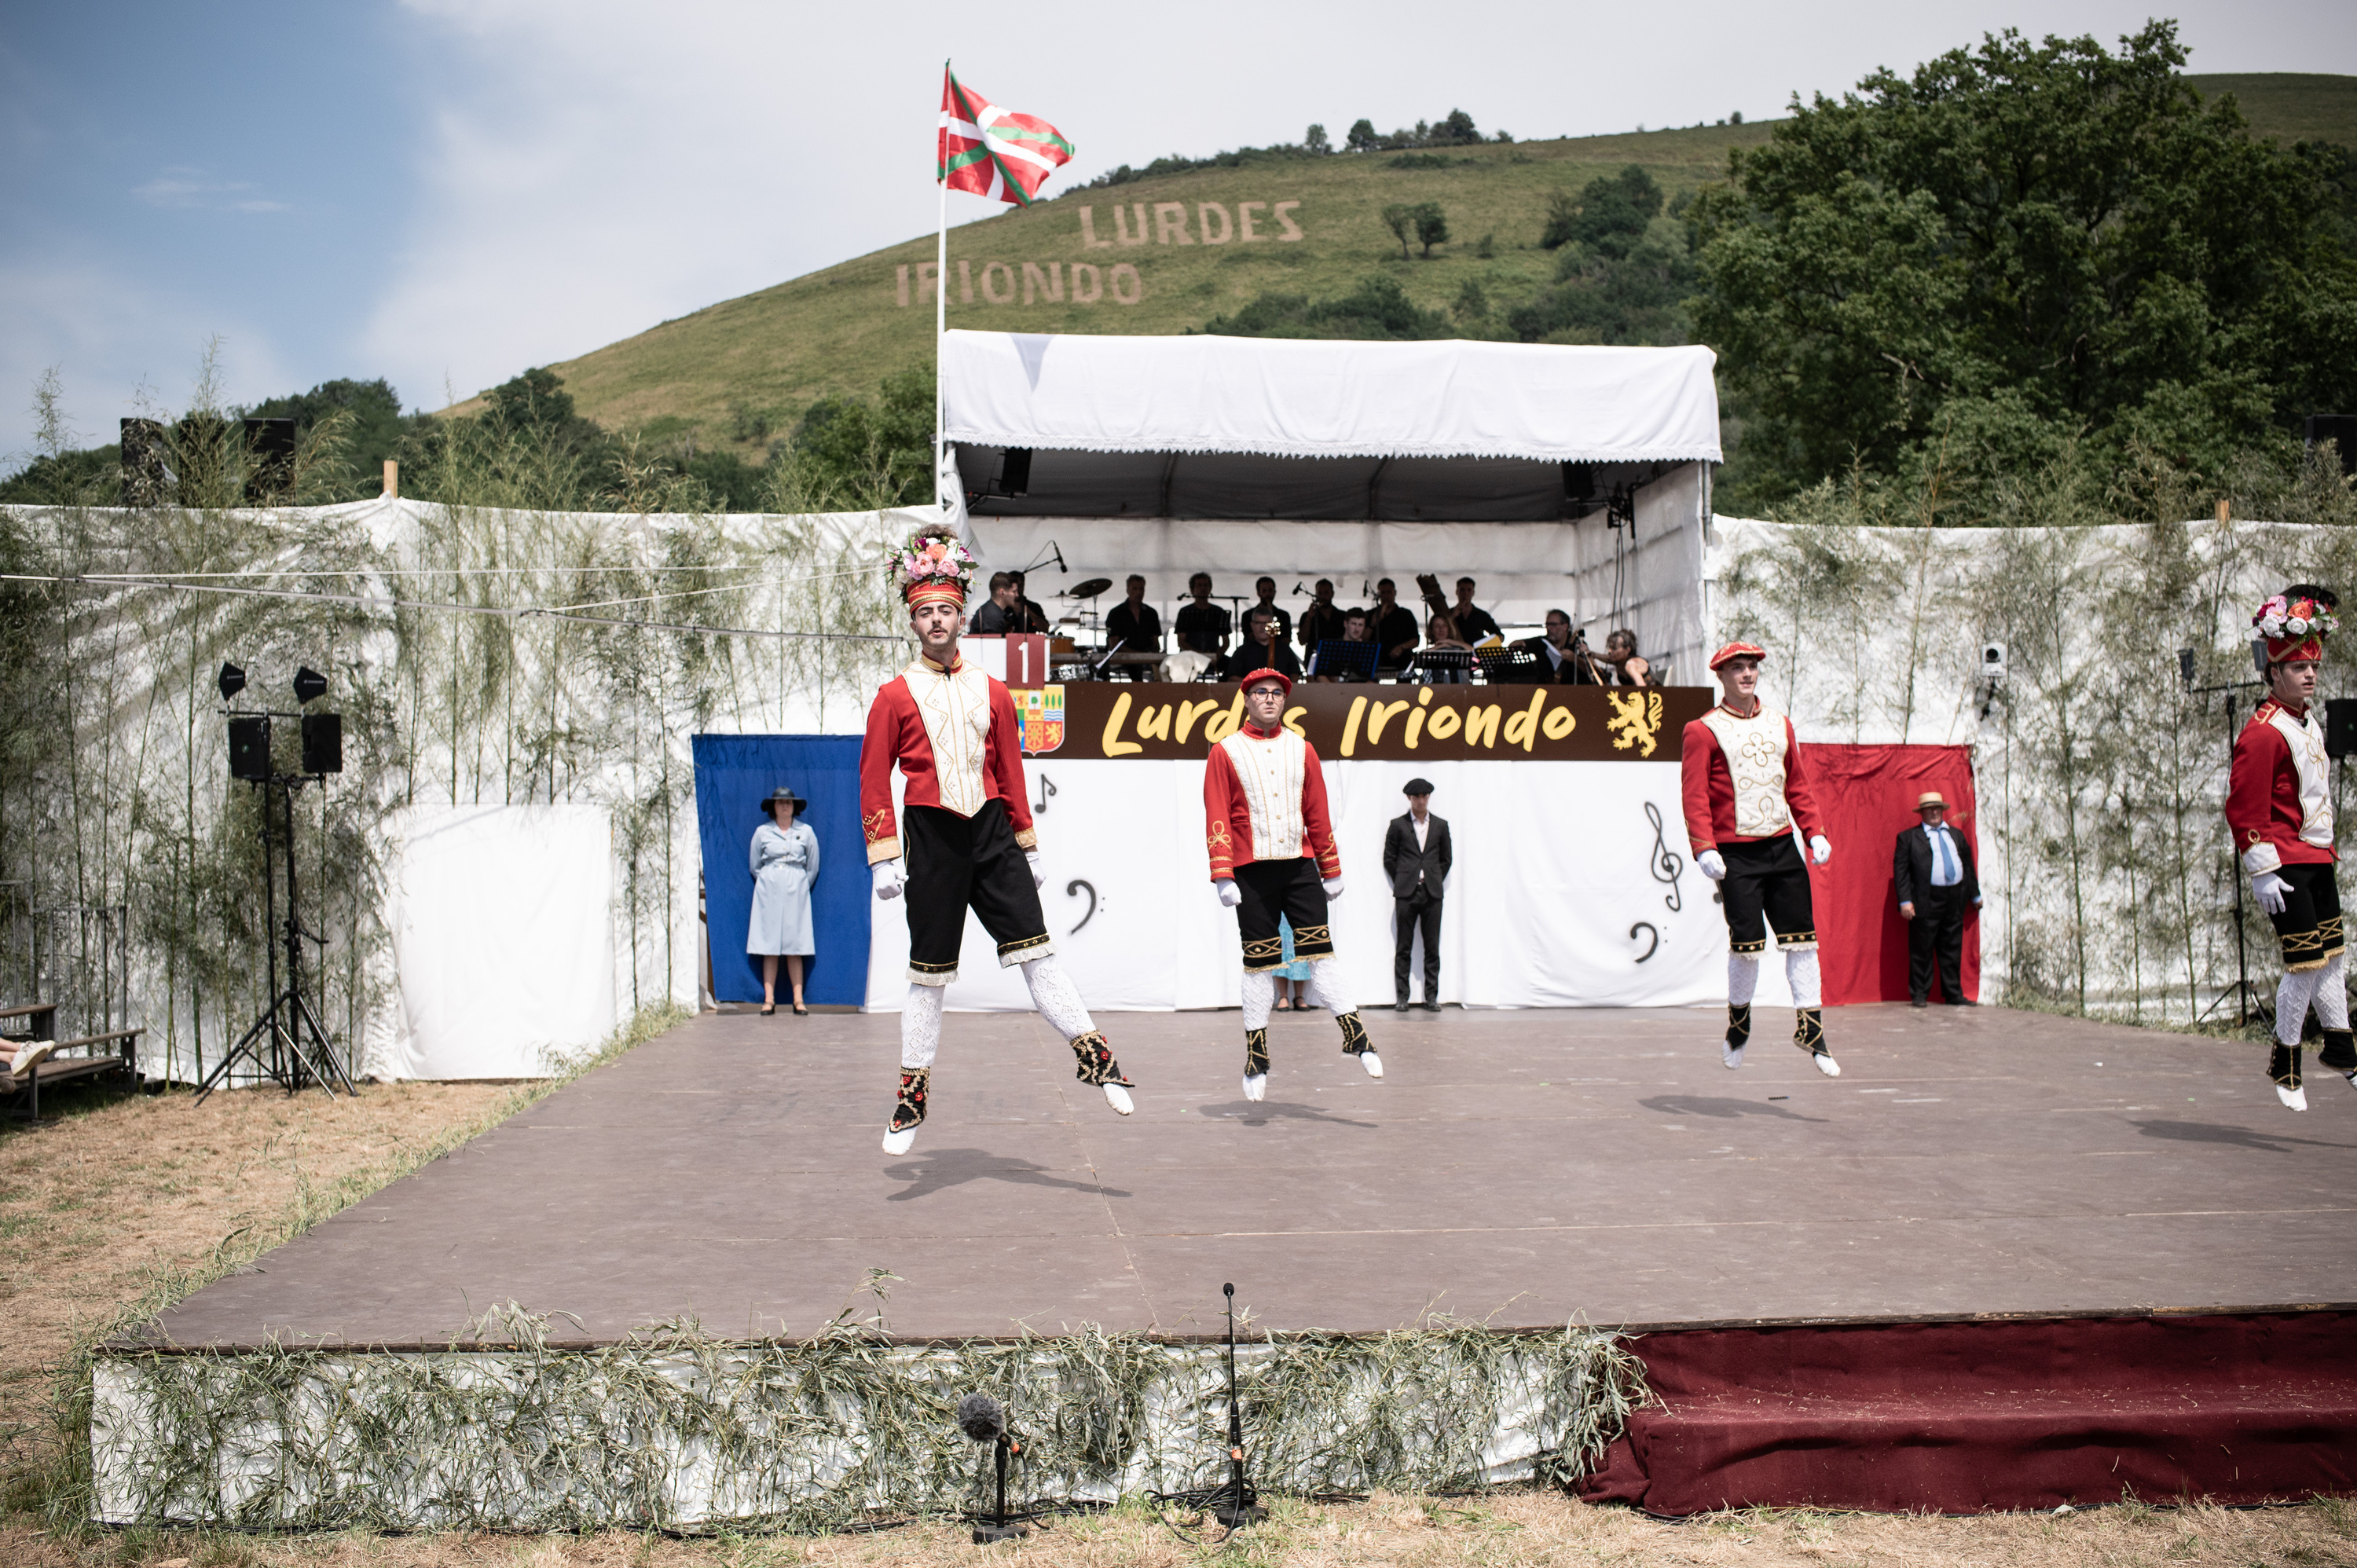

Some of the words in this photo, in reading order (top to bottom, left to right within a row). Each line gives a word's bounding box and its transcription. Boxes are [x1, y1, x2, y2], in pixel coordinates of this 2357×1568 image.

[1079, 200, 1304, 249] LURDES
[896, 260, 1142, 306] IRIONDO
[1018, 642, 1028, 683] 1
[1102, 688, 1307, 757] Lurds
[1340, 687, 1576, 757] Iriondo
